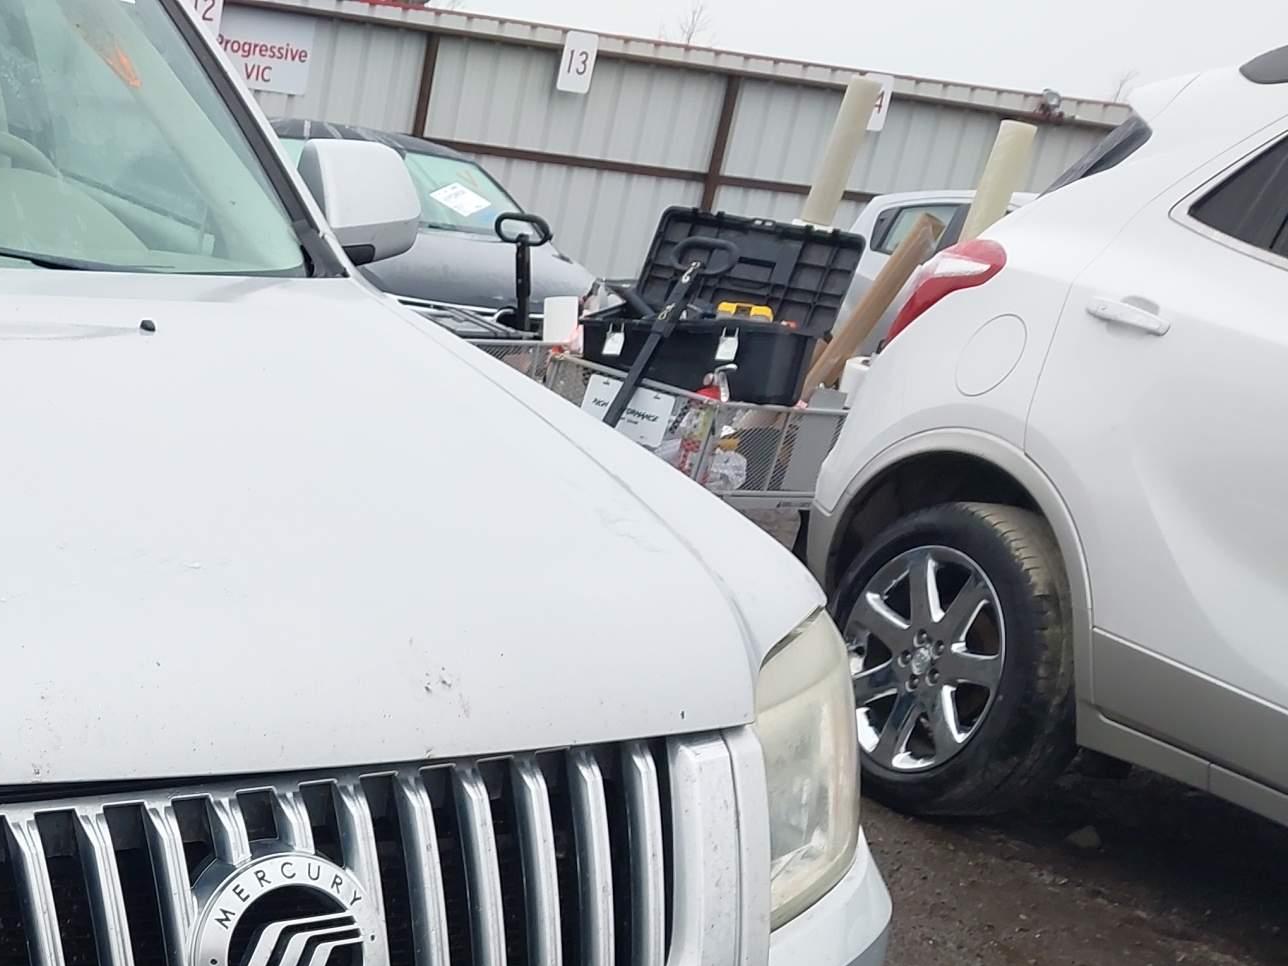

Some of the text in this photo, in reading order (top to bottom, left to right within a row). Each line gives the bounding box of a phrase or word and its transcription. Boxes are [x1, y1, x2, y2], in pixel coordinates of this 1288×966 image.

[244, 63, 273, 83] VIC
[567, 49, 589, 76] 13
[215, 862, 362, 930] MERCURY
